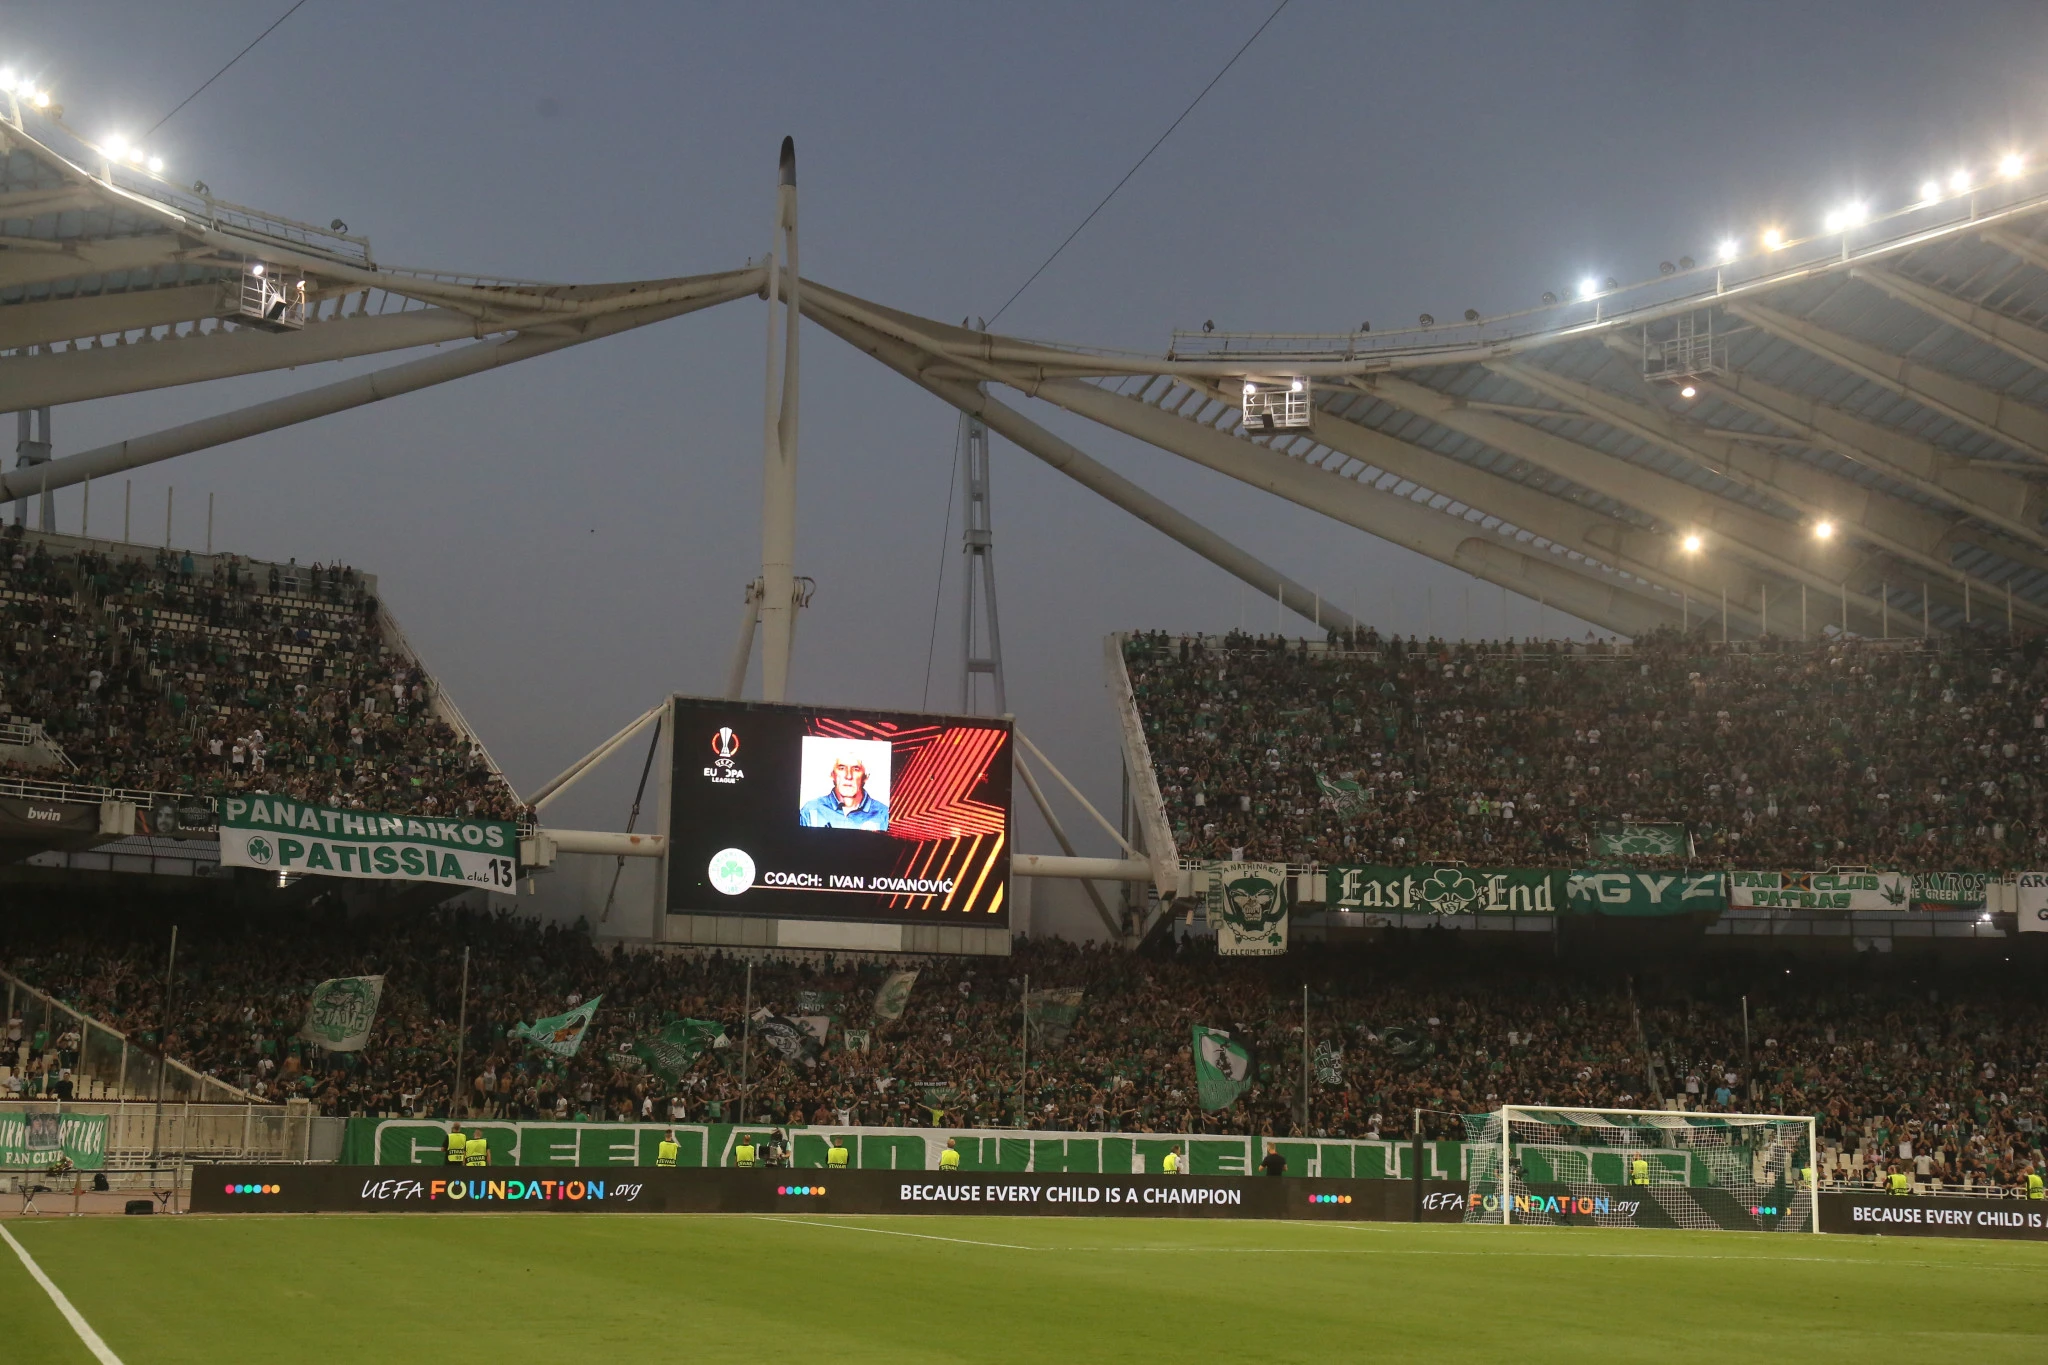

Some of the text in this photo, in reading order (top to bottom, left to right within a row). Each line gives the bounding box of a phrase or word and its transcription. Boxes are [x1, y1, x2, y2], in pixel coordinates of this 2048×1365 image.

[27, 806, 61, 822] bwin
[226, 799, 504, 848] PANATHINAIKOS
[278, 837, 513, 889] PATISSIA club 13
[764, 871, 954, 894] COACH: IVAN JOVANOVIĆ
[1338, 868, 1556, 913] East End
[1734, 872, 1880, 891] FAN CLUB
[1912, 871, 1986, 892] SKYROS
[1752, 890, 1851, 909] PATRAS
[1925, 888, 1959, 901] GREEN
[5, 1152, 30, 1165] FAN
[361, 1179, 424, 1199] UEFA
[609, 1181, 643, 1201] .org
[900, 1184, 1241, 1205] BECAUSE EVERY CHILD IS A CHAMPION
[1612, 1199, 1640, 1217] .org
[1853, 1207, 1922, 1224] BECAUSE
[1926, 1209, 1973, 1225] EVERY
[1976, 1210, 2024, 1228] CHILD
[2028, 1212, 2042, 1228] IS
